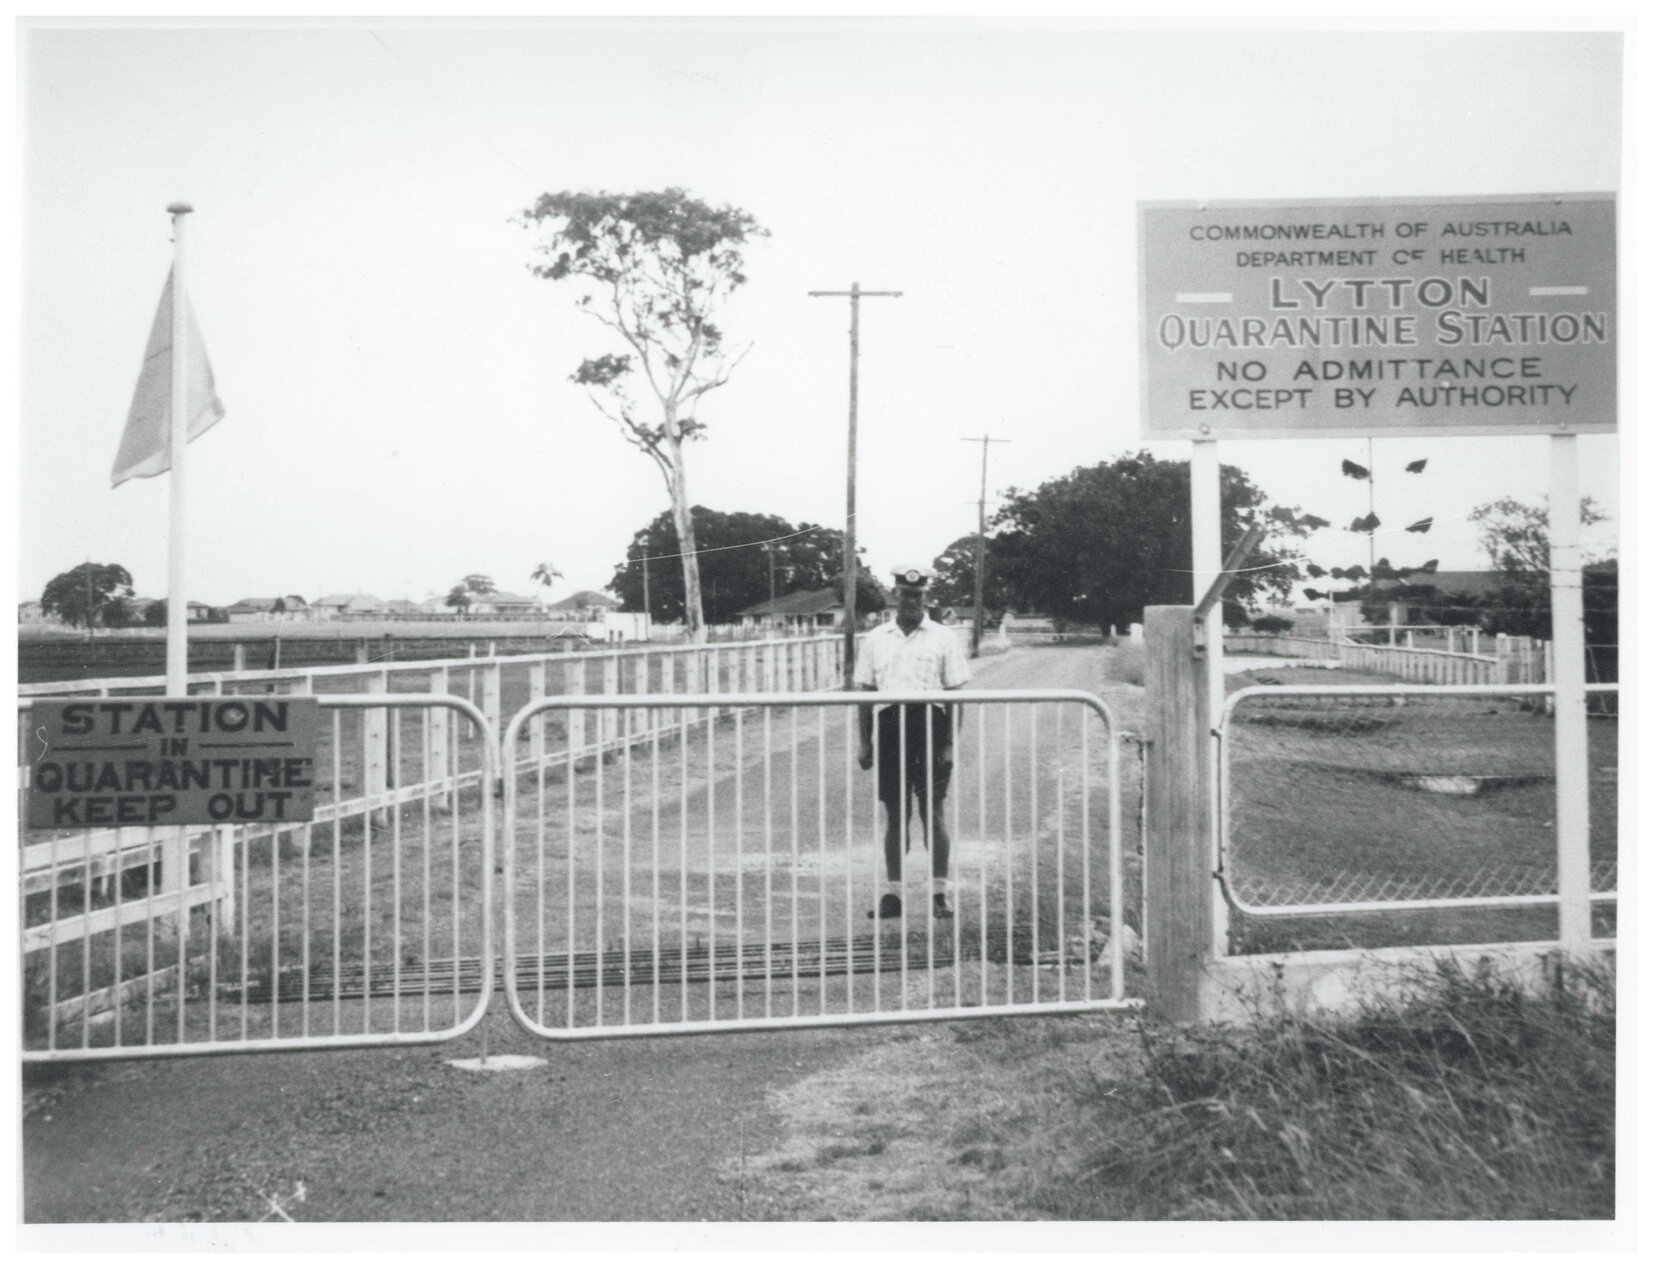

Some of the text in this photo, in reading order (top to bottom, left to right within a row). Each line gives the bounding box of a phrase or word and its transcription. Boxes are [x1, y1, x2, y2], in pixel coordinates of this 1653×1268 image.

[1189, 221, 1572, 241] COMMONWEALTH OF AUSTRALIA
[1236, 248, 1525, 267] DEPARTMENT OF HEALTH
[1270, 278, 1490, 309] LYTTON
[1159, 310, 1606, 353] QUARANTINE STATION
[1216, 358, 1542, 382] NO ADMITTANCE
[1189, 384, 1578, 410] EXCEPT BY AUTHORITY
[62, 702, 289, 734] STATION
[160, 738, 189, 756] IN
[36, 758, 313, 792] QUARANTINE
[54, 792, 292, 823] KEEP OUT
